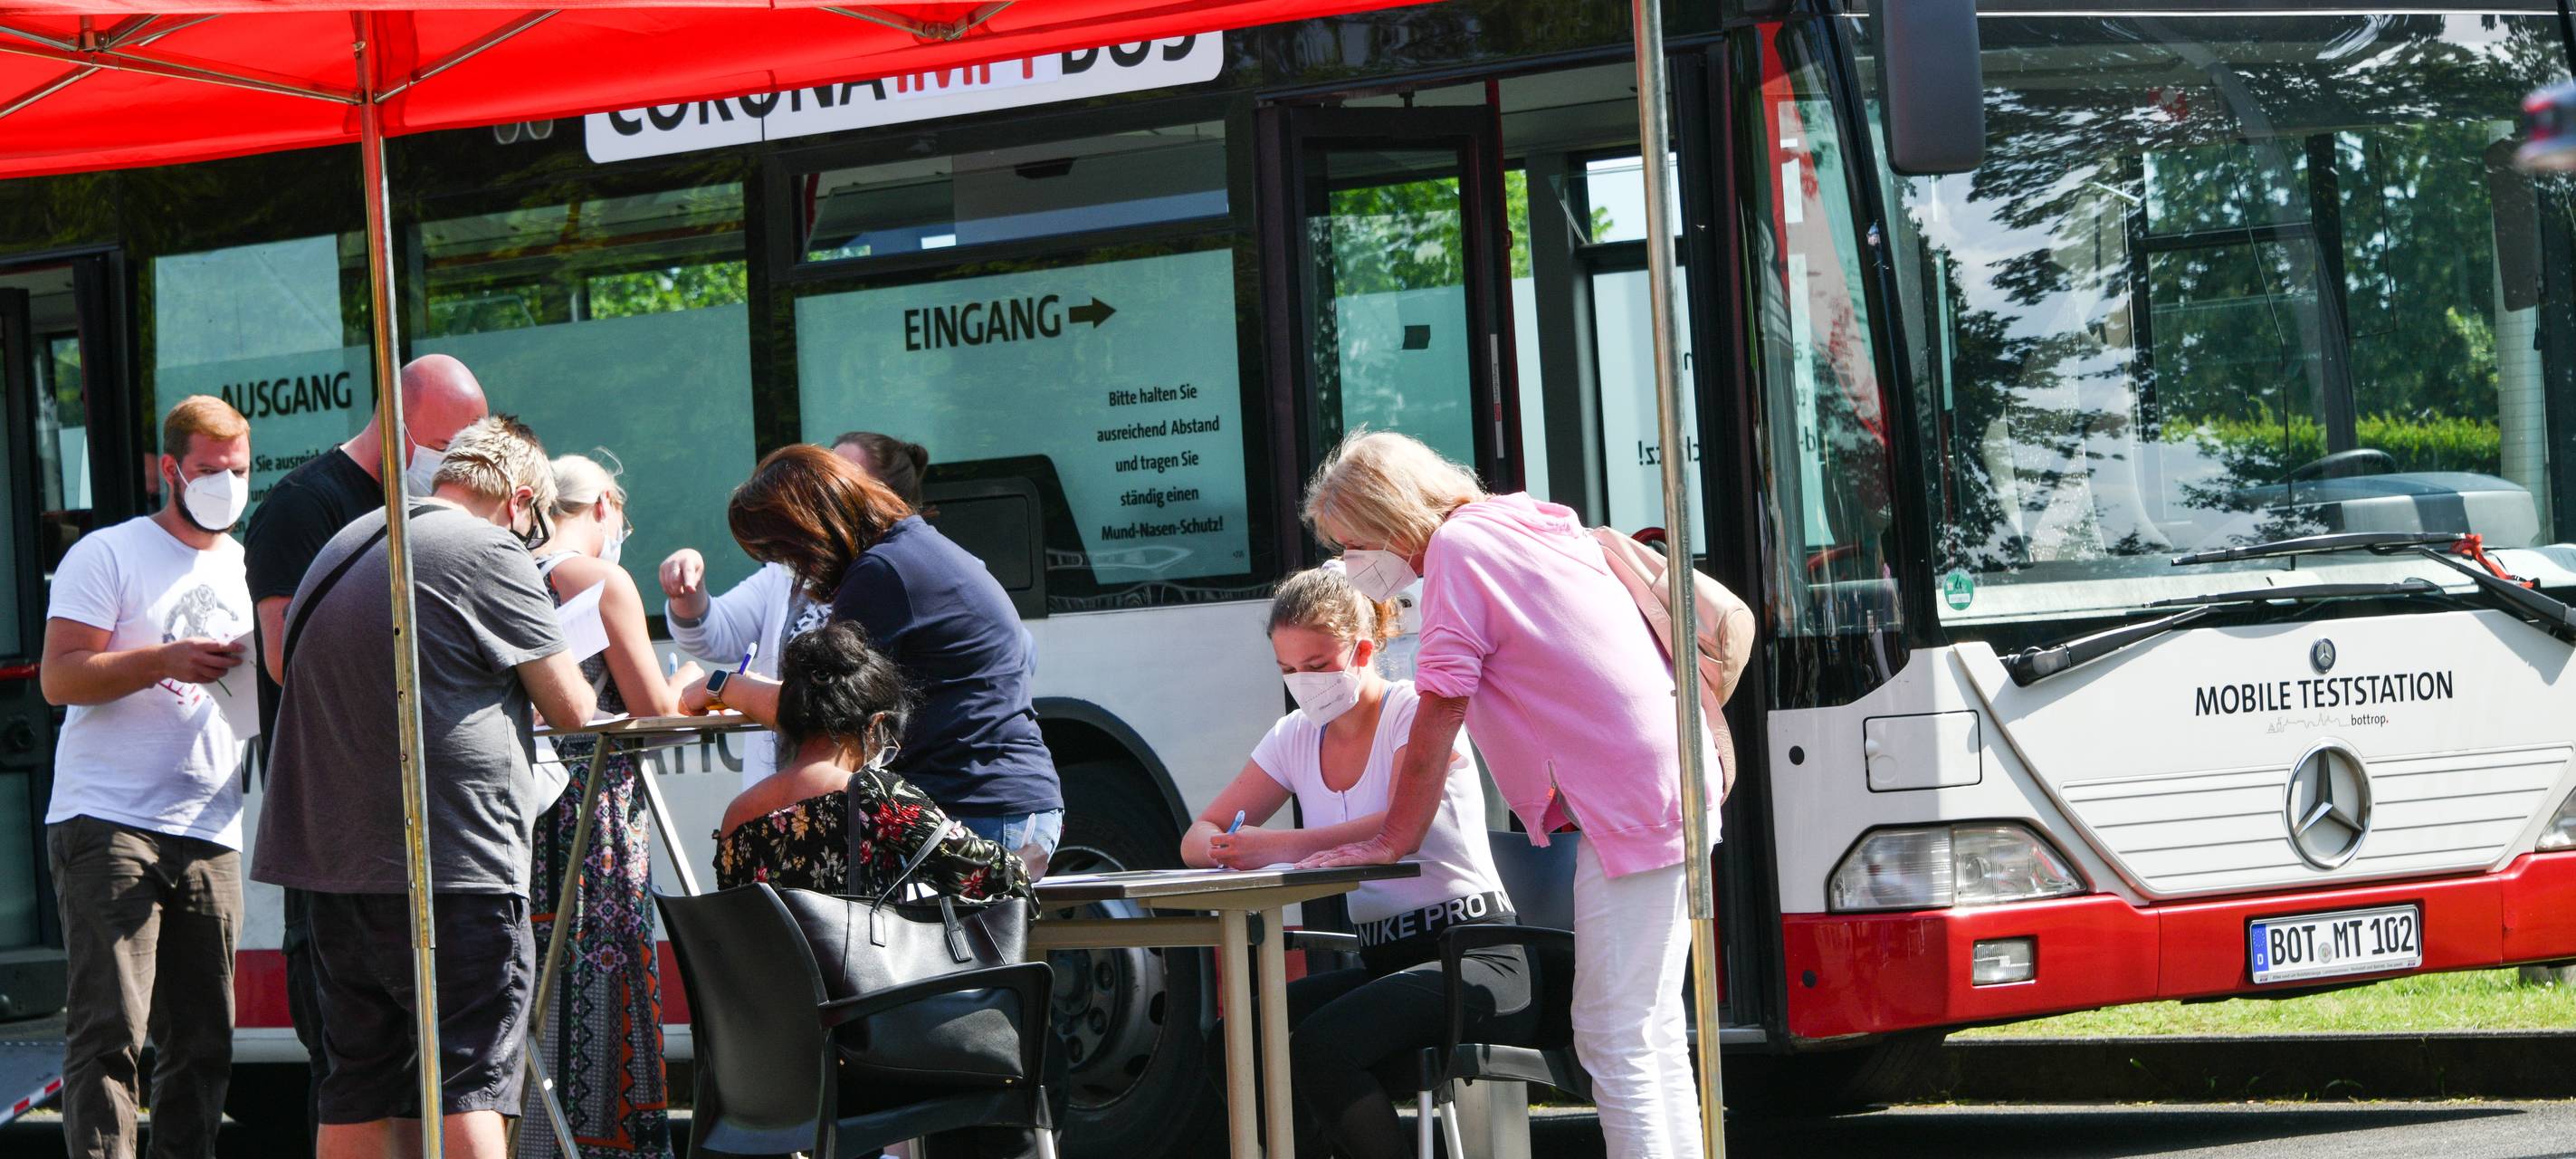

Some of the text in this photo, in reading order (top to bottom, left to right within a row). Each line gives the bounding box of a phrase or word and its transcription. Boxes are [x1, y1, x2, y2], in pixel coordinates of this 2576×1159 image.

[904, 294, 1062, 351] EINGANG
[222, 372, 353, 419] AUSGANG
[1109, 384, 1197, 407] Bitte halten Sie
[1097, 416, 1220, 442] ausreichend Abstand
[255, 455, 272, 472] Sie
[1116, 450, 1199, 474] und tragen Sie
[1121, 486, 1199, 508] ständig einen
[1102, 515, 1224, 541] Mund-Nasen-Schutz!
[2195, 670, 2454, 716] MOBILE TESTSTATION
[2351, 714, 2390, 727] bottrop.
[1359, 913, 1417, 948] NIKE
[1424, 893, 1487, 932] PRO
[2270, 915, 2415, 965] BOT MT 102
[2256, 953, 2264, 966] D
